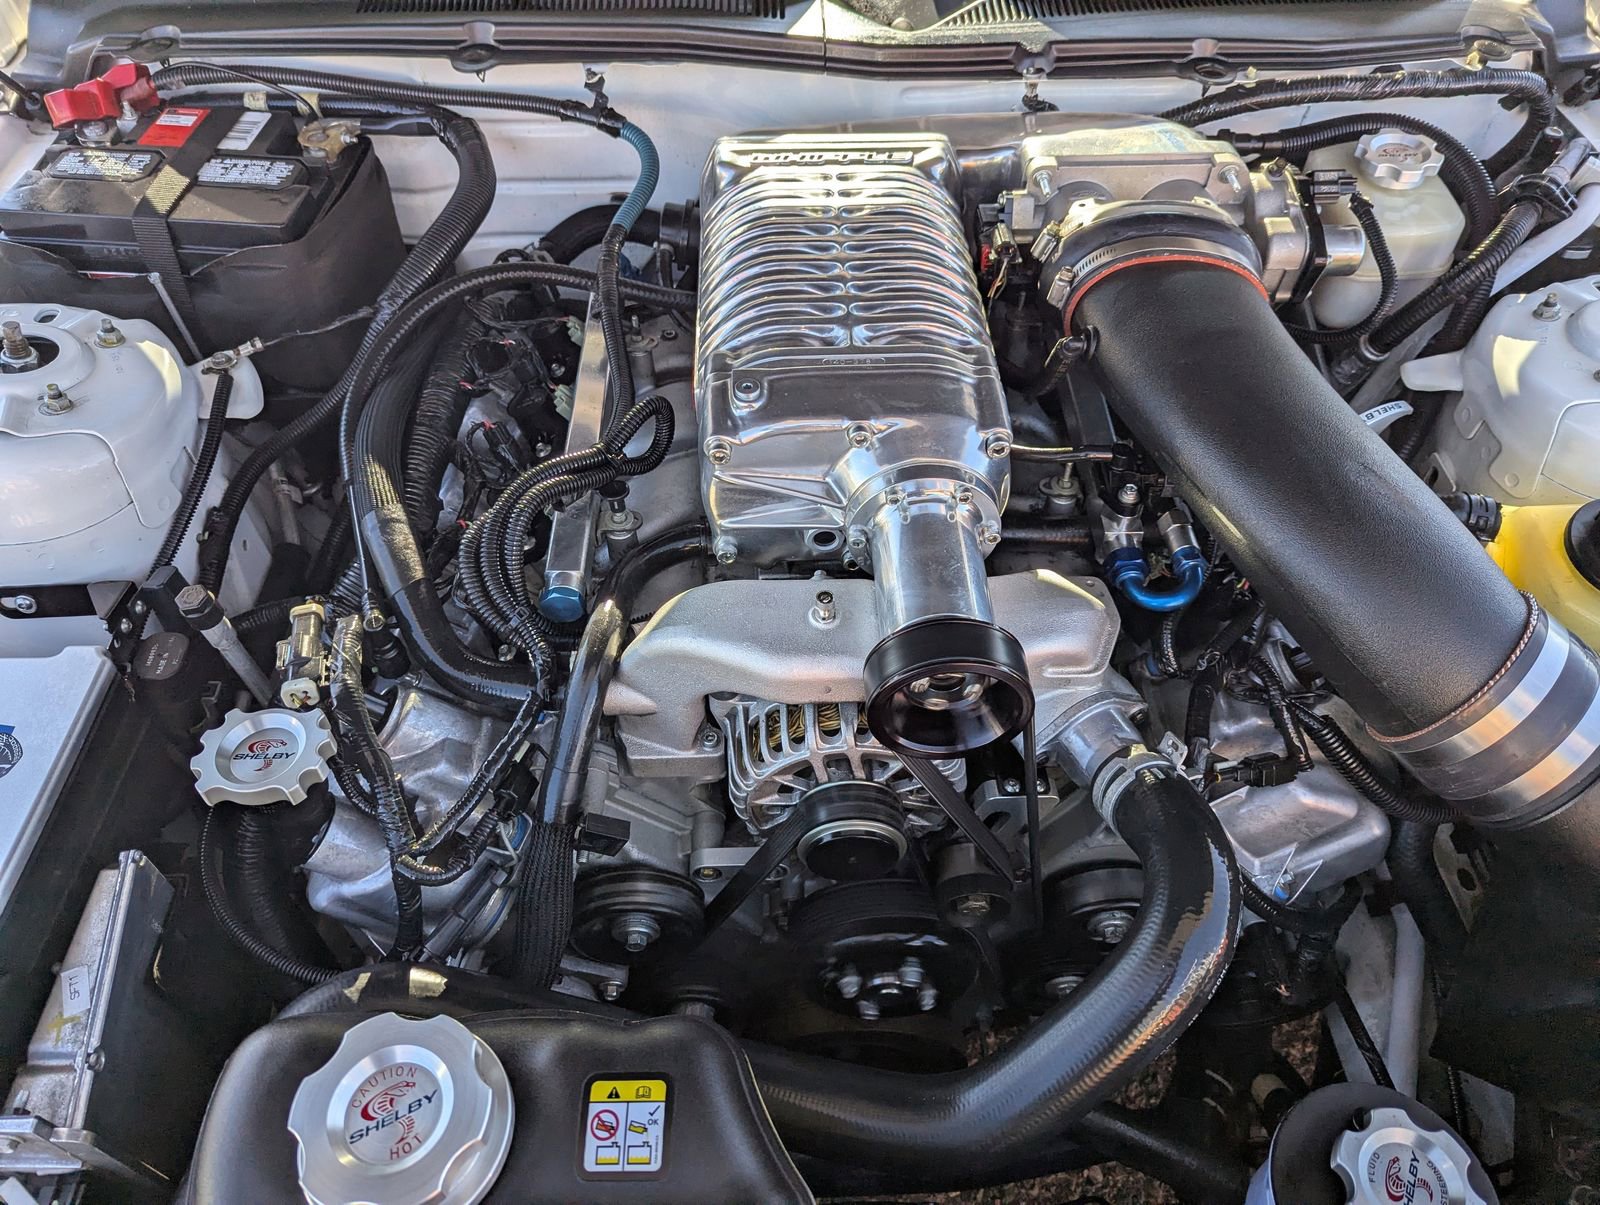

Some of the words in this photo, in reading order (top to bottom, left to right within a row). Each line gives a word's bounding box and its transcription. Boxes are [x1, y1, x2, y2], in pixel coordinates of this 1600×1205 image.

[1365, 402, 1403, 421] SHELB
[233, 752, 296, 761] SHELBY
[351, 1066, 418, 1109] CAUTION
[349, 1089, 438, 1145] SHELBY
[647, 1118, 659, 1126] OK
[389, 1133, 422, 1160] HOT
[1368, 1152, 1381, 1184] FLUID
[1403, 1150, 1420, 1205] HELBY
[1426, 1160, 1448, 1205] STEERING
